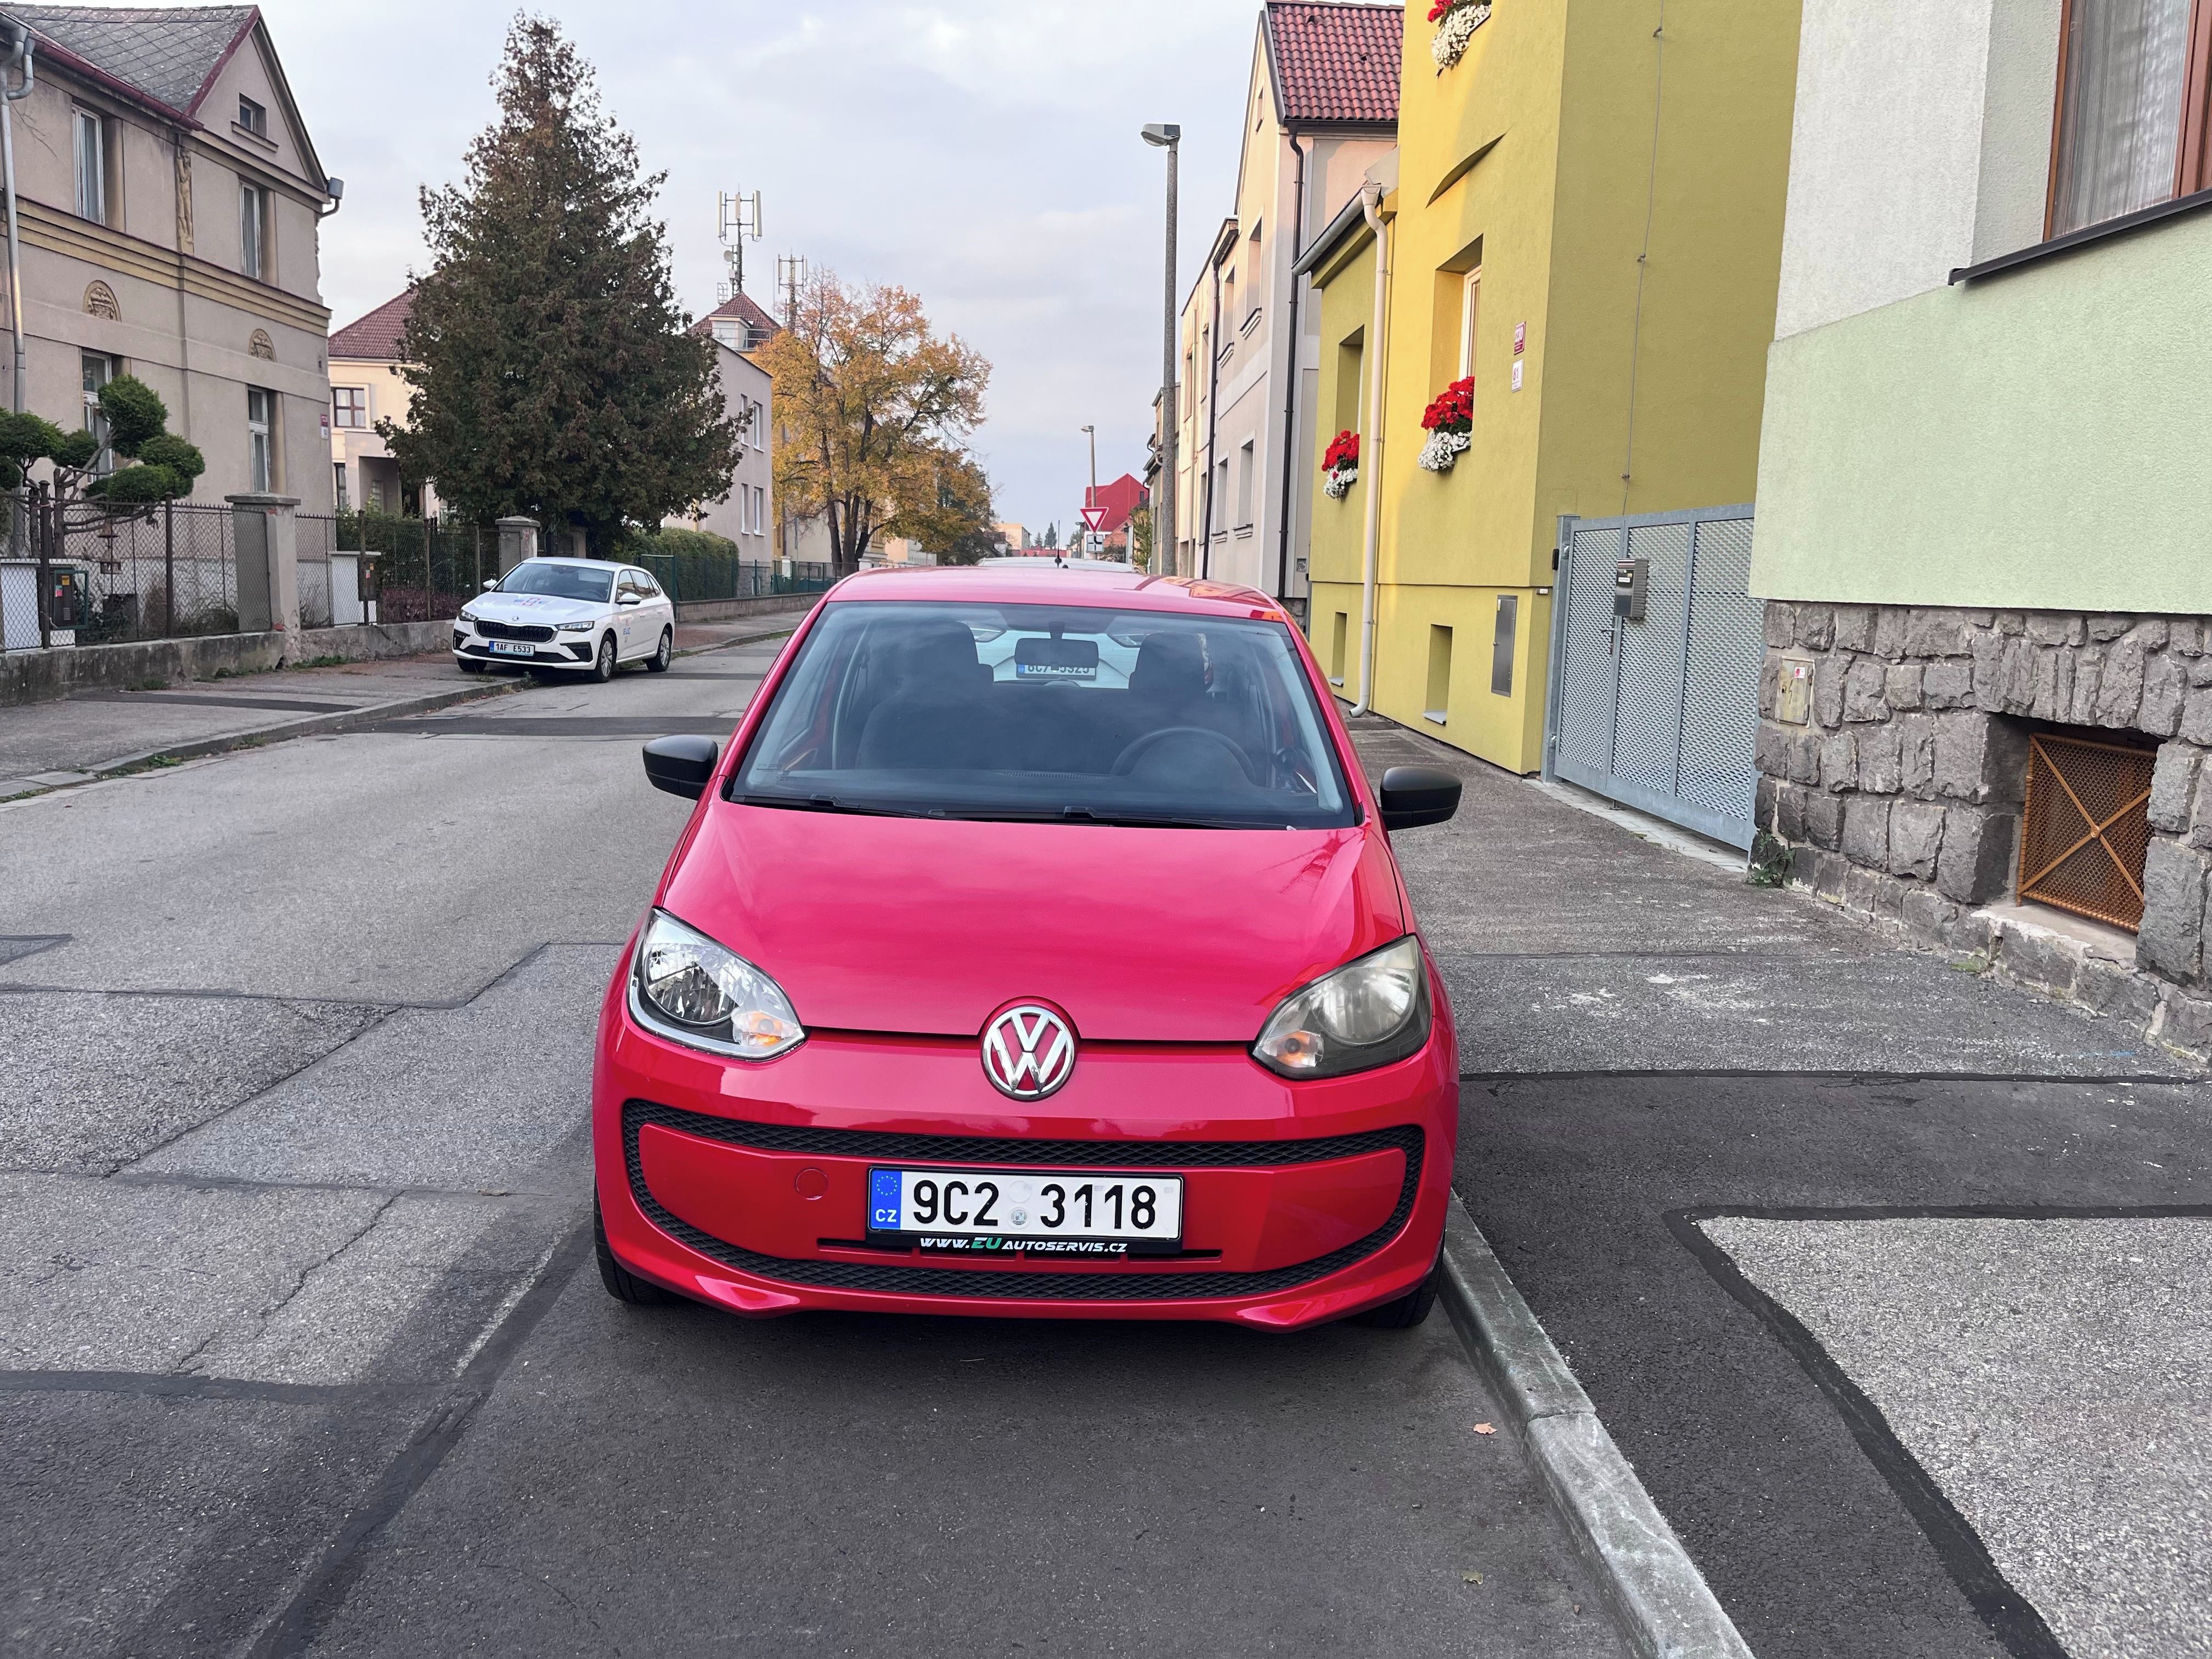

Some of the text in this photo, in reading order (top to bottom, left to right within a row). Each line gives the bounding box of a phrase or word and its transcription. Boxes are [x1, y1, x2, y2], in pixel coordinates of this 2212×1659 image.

[496, 643, 508, 651] 1AF
[513, 645, 531, 653] E533
[874, 1179, 1156, 1230] CZ 9C2 3118
